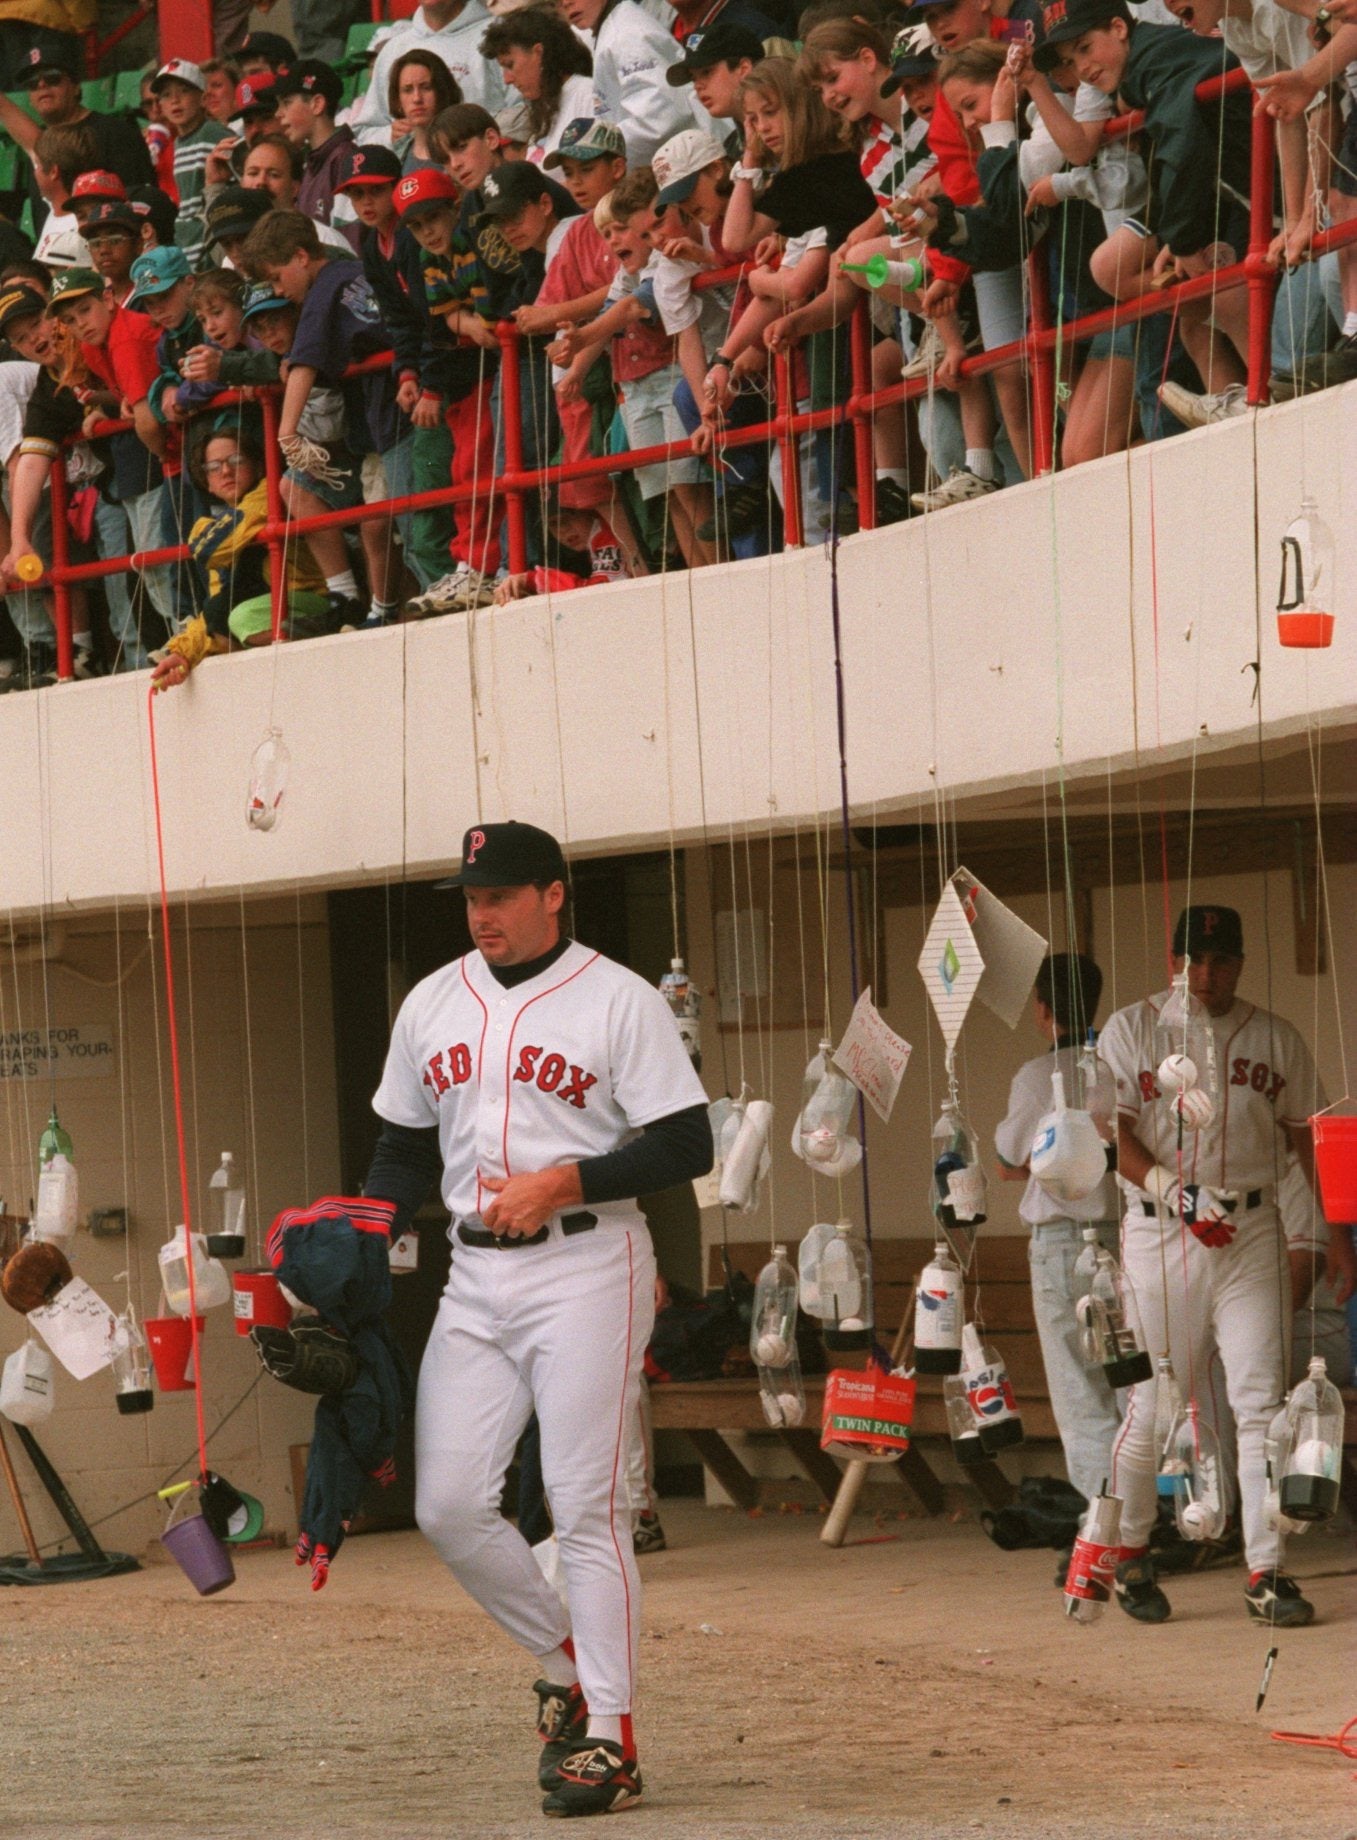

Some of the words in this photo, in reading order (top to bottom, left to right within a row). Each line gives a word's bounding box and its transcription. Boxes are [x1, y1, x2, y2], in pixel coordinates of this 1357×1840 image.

[351, 152, 366, 175] P
[466, 830, 486, 864] P
[1203, 912, 1220, 935] P
[48, 1028, 80, 1043] FOR
[66, 1042, 109, 1057] YOUR
[513, 1045, 598, 1109] SOX
[1230, 1057, 1287, 1103] SOX
[837, 1377, 875, 1393] Tropicana
[836, 1416, 871, 1432] TWIN
[873, 1421, 908, 1438] PACK
